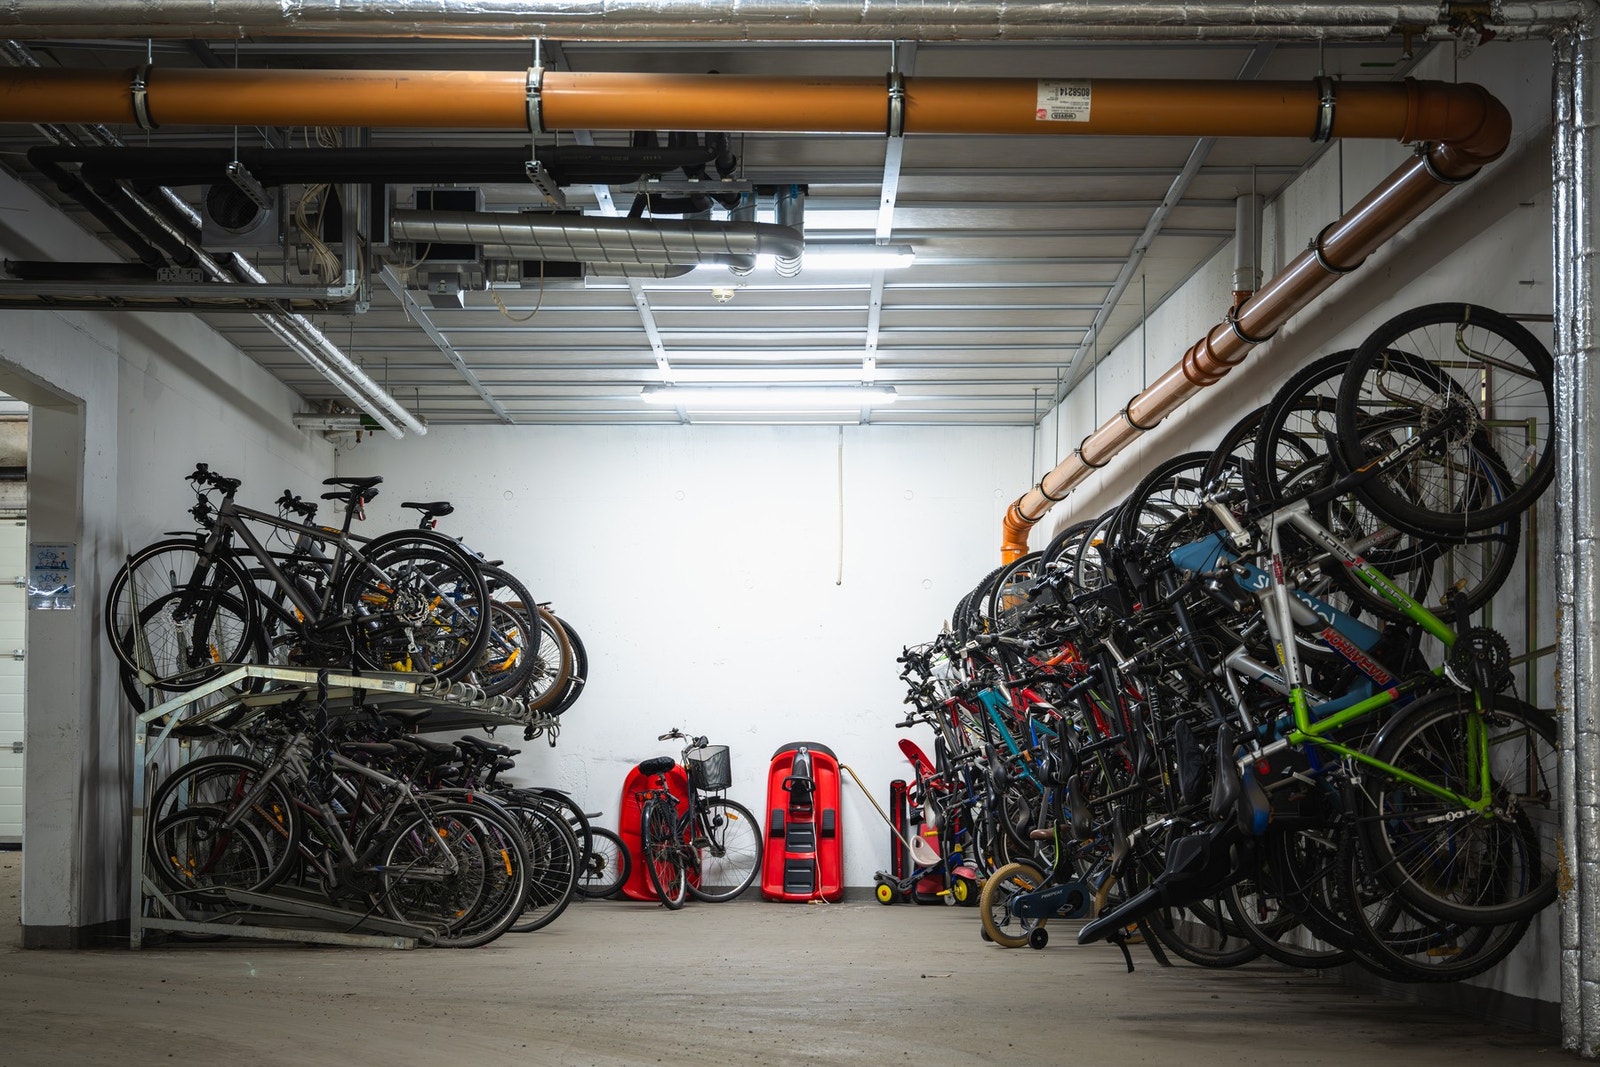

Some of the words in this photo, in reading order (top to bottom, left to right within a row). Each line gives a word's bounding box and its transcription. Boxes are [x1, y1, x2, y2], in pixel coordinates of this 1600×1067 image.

[1060, 87, 1090, 97] 8058214
[1378, 436, 1421, 468] HEAD
[1320, 627, 1392, 686] MARATHON
